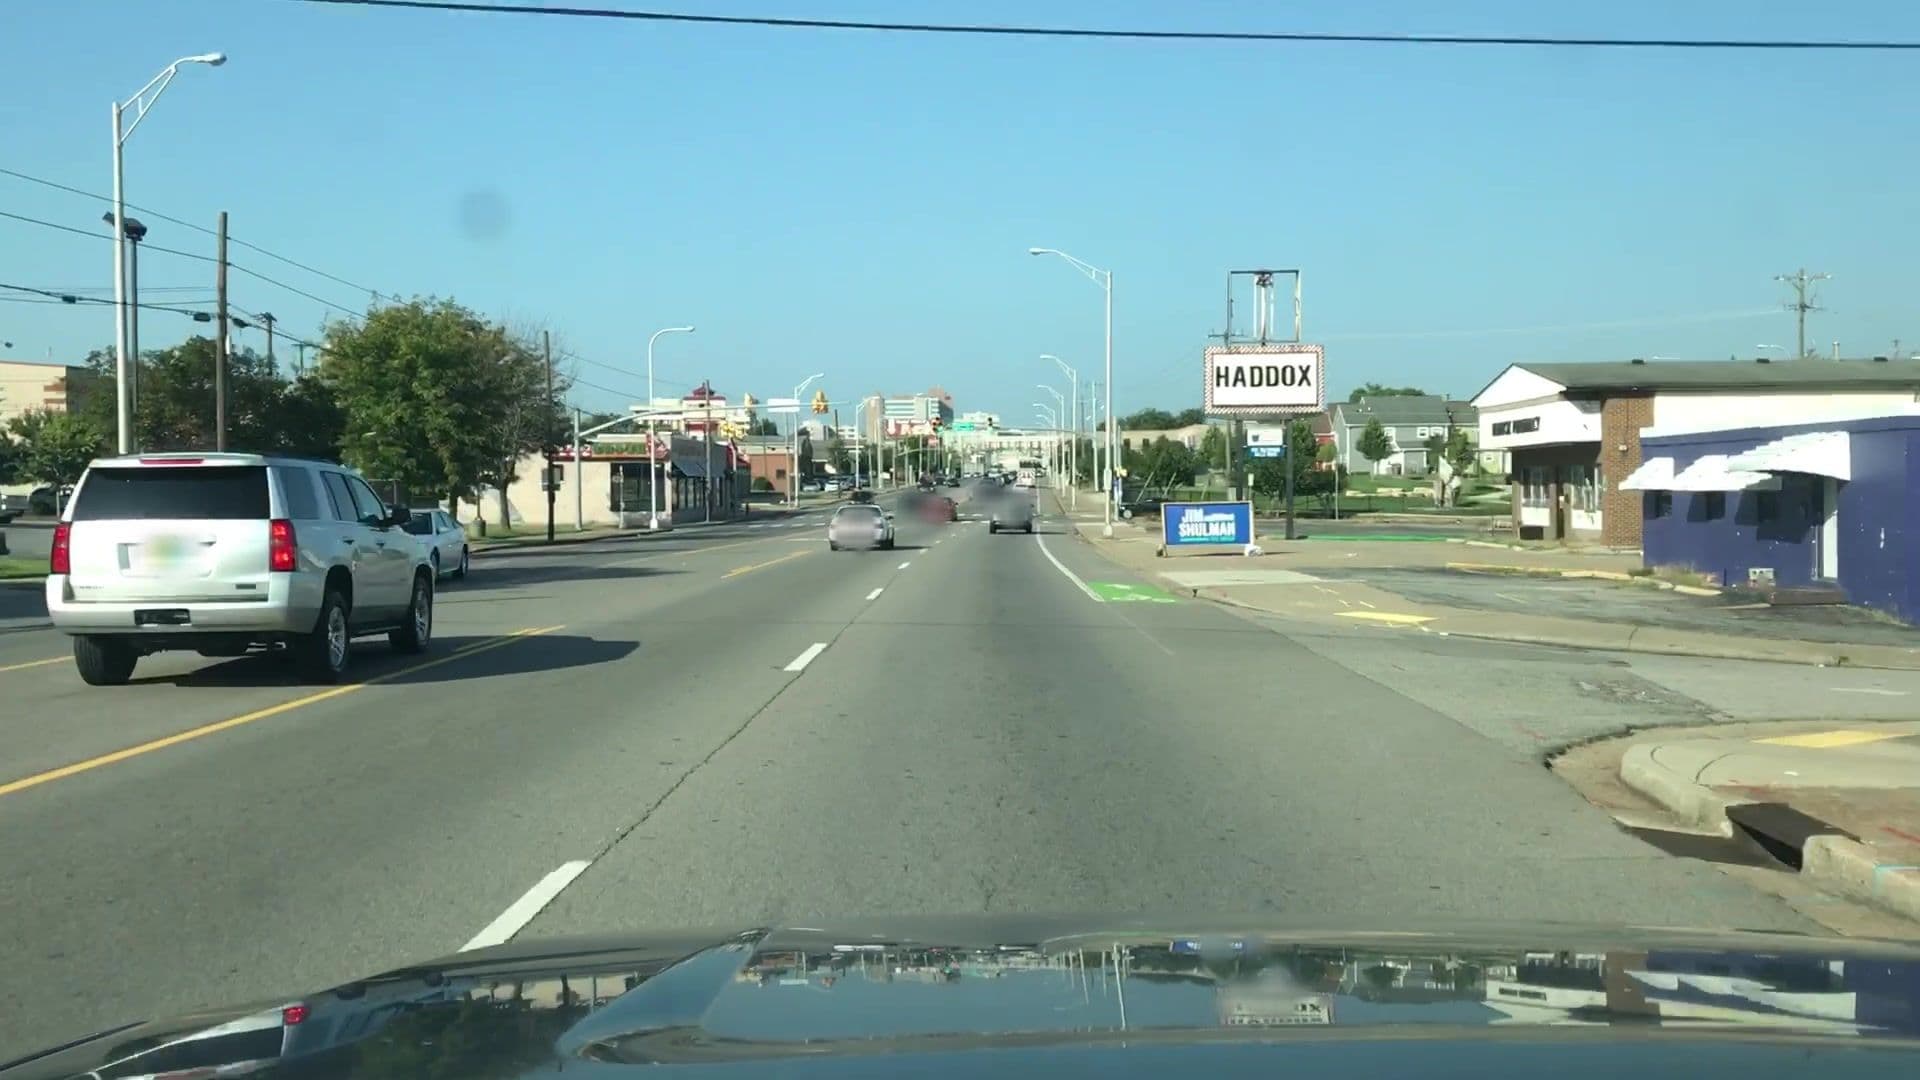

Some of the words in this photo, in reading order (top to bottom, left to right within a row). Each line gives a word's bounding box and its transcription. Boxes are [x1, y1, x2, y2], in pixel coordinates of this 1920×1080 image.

[1215, 364, 1311, 388] HADDOX
[1181, 508, 1204, 522] JIM
[1178, 520, 1236, 537] SHULMAN
